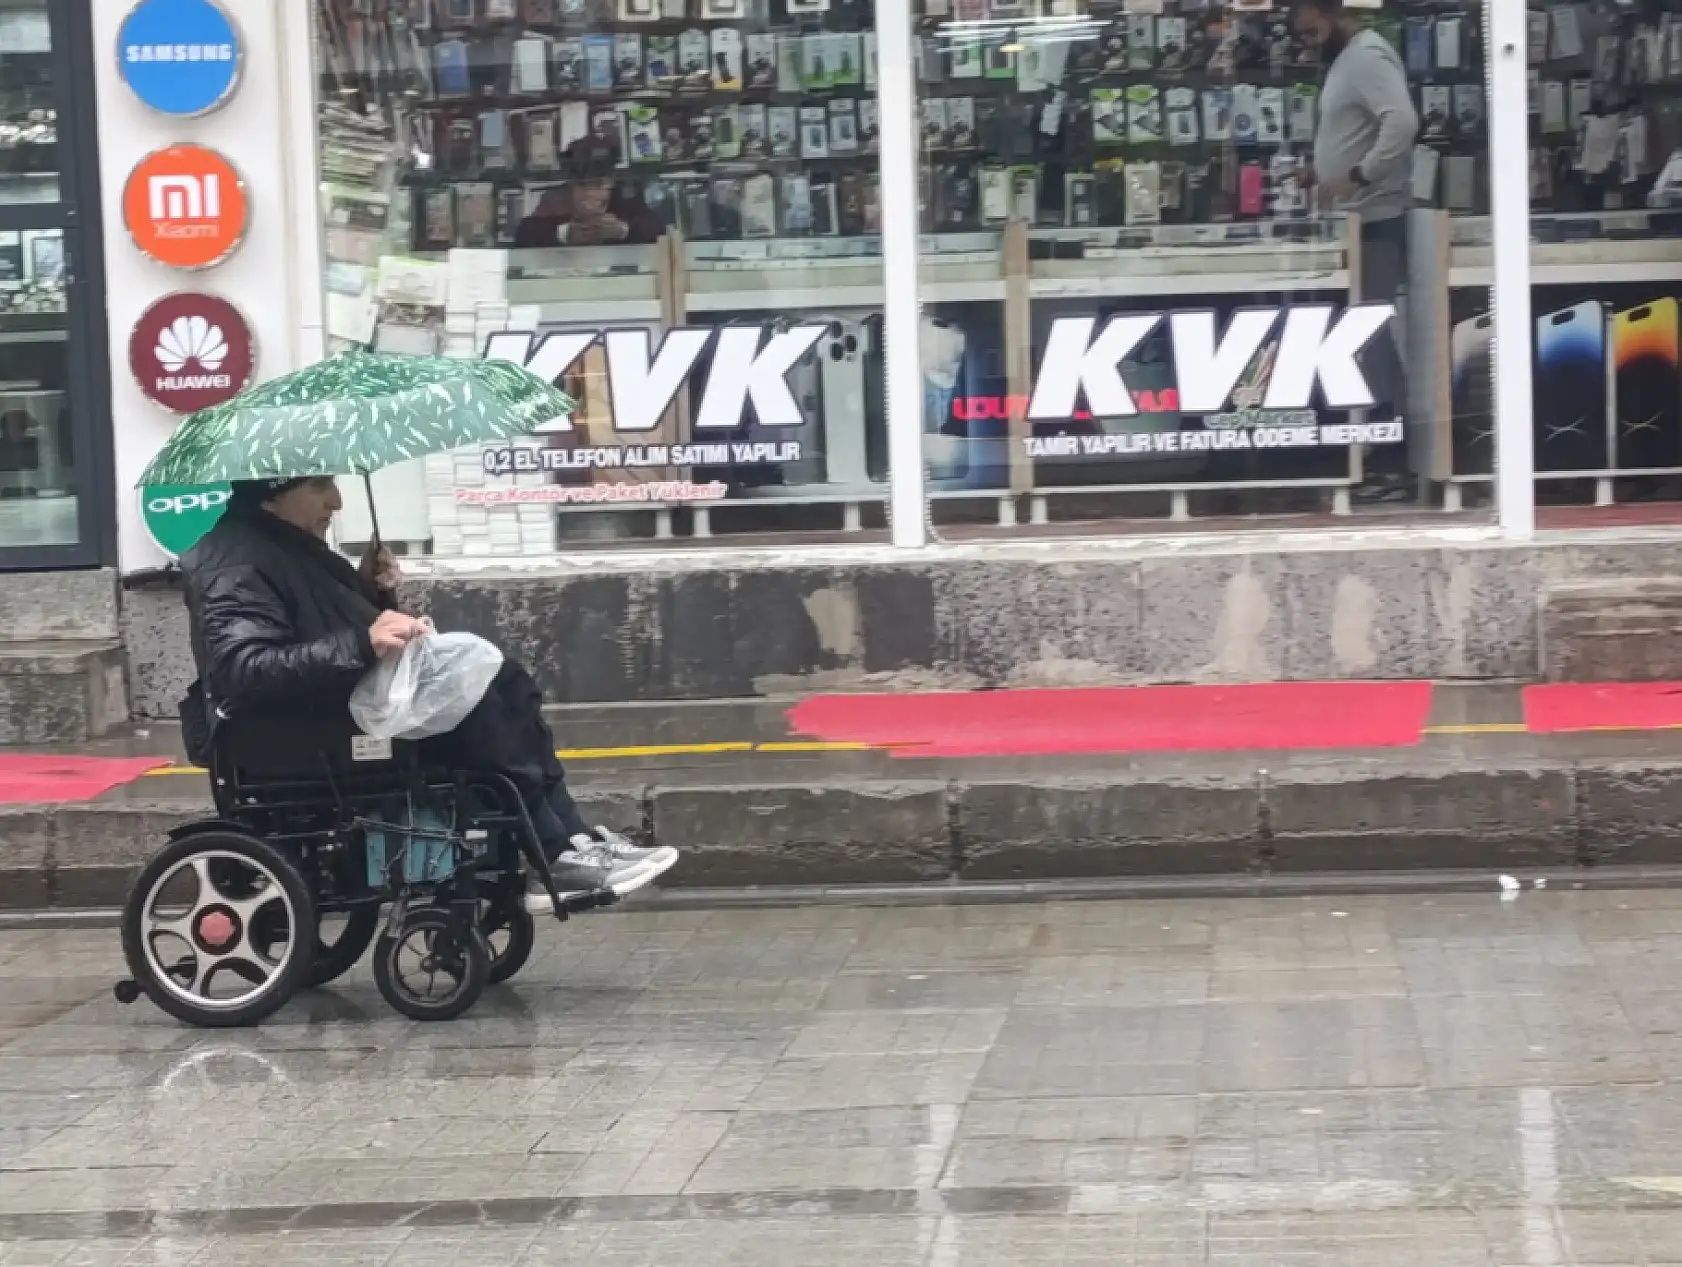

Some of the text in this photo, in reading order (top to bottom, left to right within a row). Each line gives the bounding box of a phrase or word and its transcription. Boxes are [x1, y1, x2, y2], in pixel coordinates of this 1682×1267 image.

[126, 43, 233, 63] SAMSUNG
[154, 222, 220, 239] Xiaomi
[1028, 303, 1395, 420] KVK
[156, 374, 231, 391] HUAWEI
[484, 324, 829, 432] KVK
[1081, 433, 1149, 454] YAPILIR
[1152, 431, 1180, 452] VE
[1181, 428, 1250, 450] FATURA
[541, 447, 621, 470] TELEFON
[624, 446, 668, 467] ALIM
[671, 443, 729, 465] SATIMI
[731, 441, 800, 463] YAPILIR
[148, 490, 233, 514] opp
